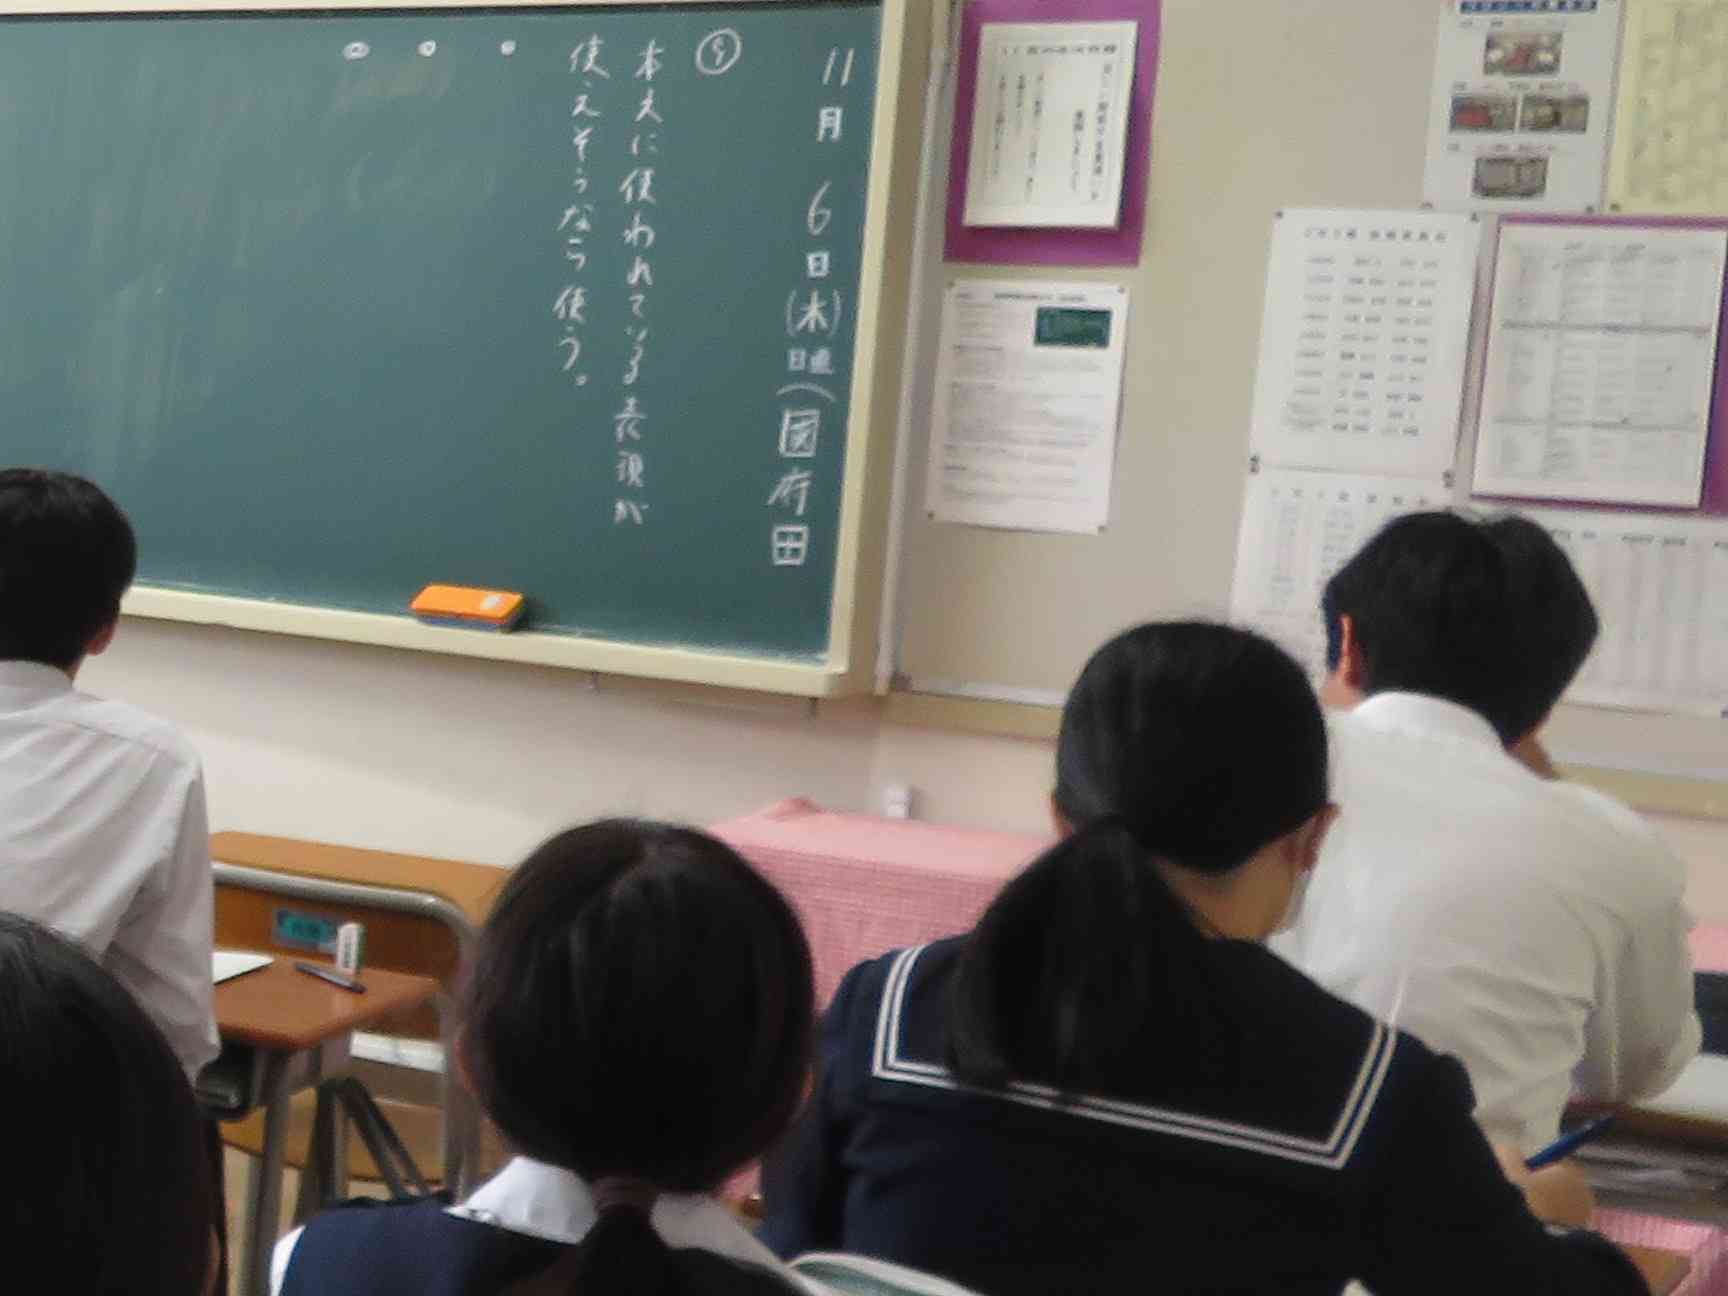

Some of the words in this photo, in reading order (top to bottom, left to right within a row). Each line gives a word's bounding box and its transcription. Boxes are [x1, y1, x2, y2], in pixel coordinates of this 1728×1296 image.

[552, 33, 611, 386] 使えそうなら使う。
